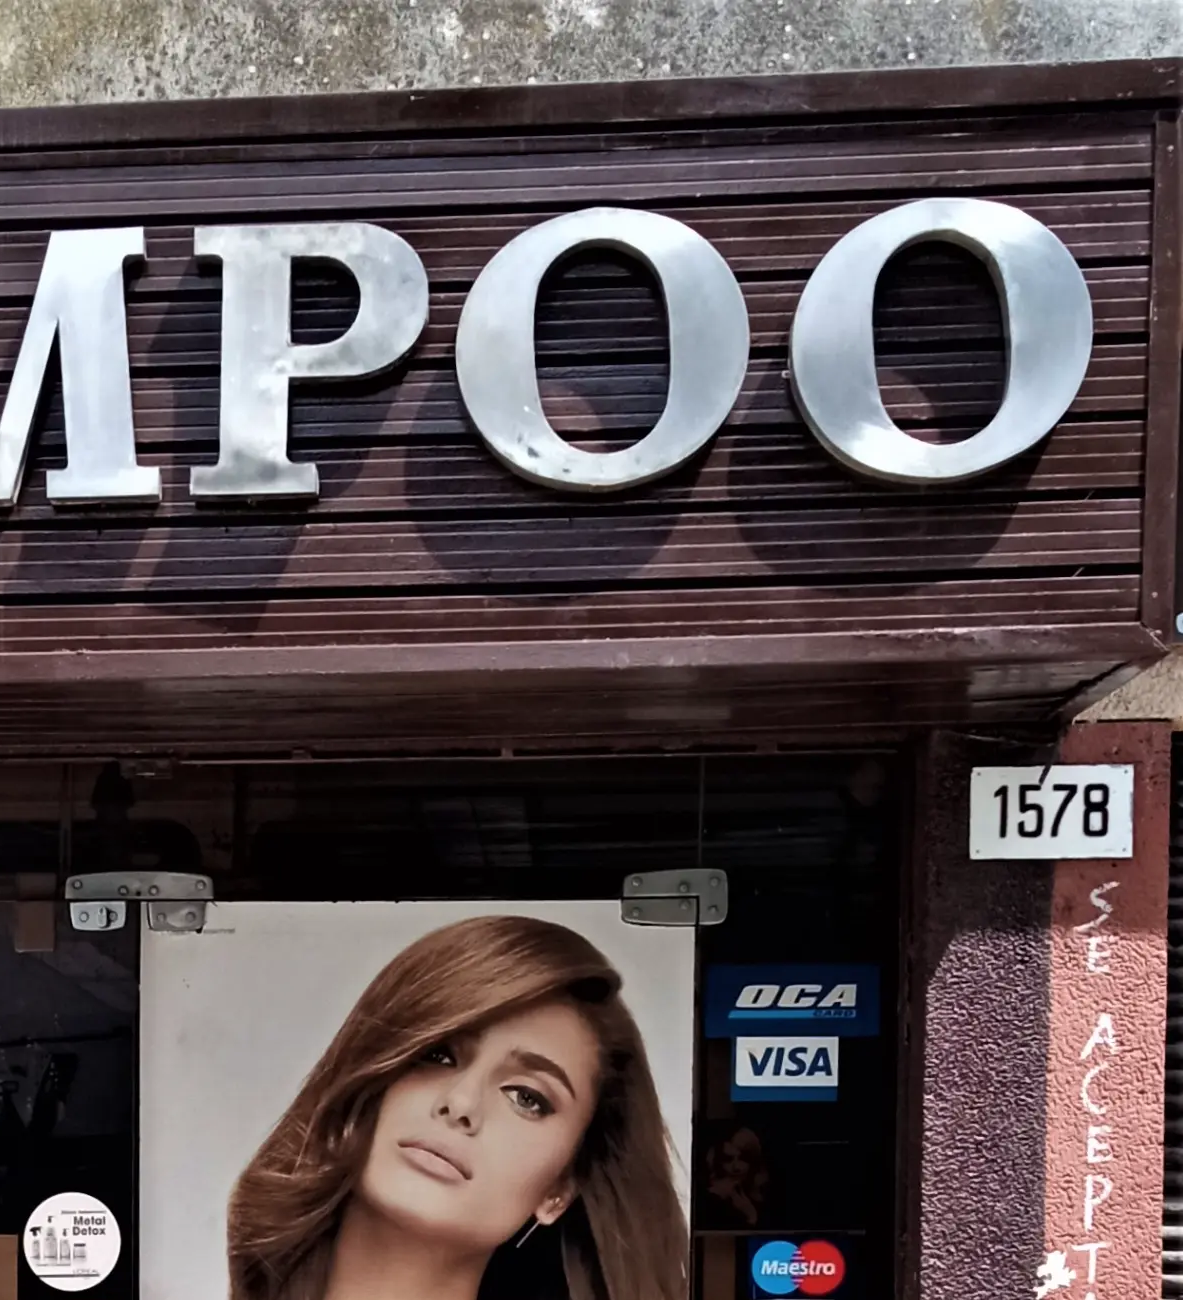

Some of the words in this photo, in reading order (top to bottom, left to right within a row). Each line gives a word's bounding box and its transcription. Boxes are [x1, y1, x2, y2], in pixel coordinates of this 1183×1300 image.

[994, 783, 1111, 839] 1578
[735, 984, 857, 1008] OCA
[748, 1046, 833, 1077] VISA
[73, 1215, 106, 1226] Metal
[72, 1226, 106, 1236] Detox
[760, 1259, 836, 1276] Maestro
